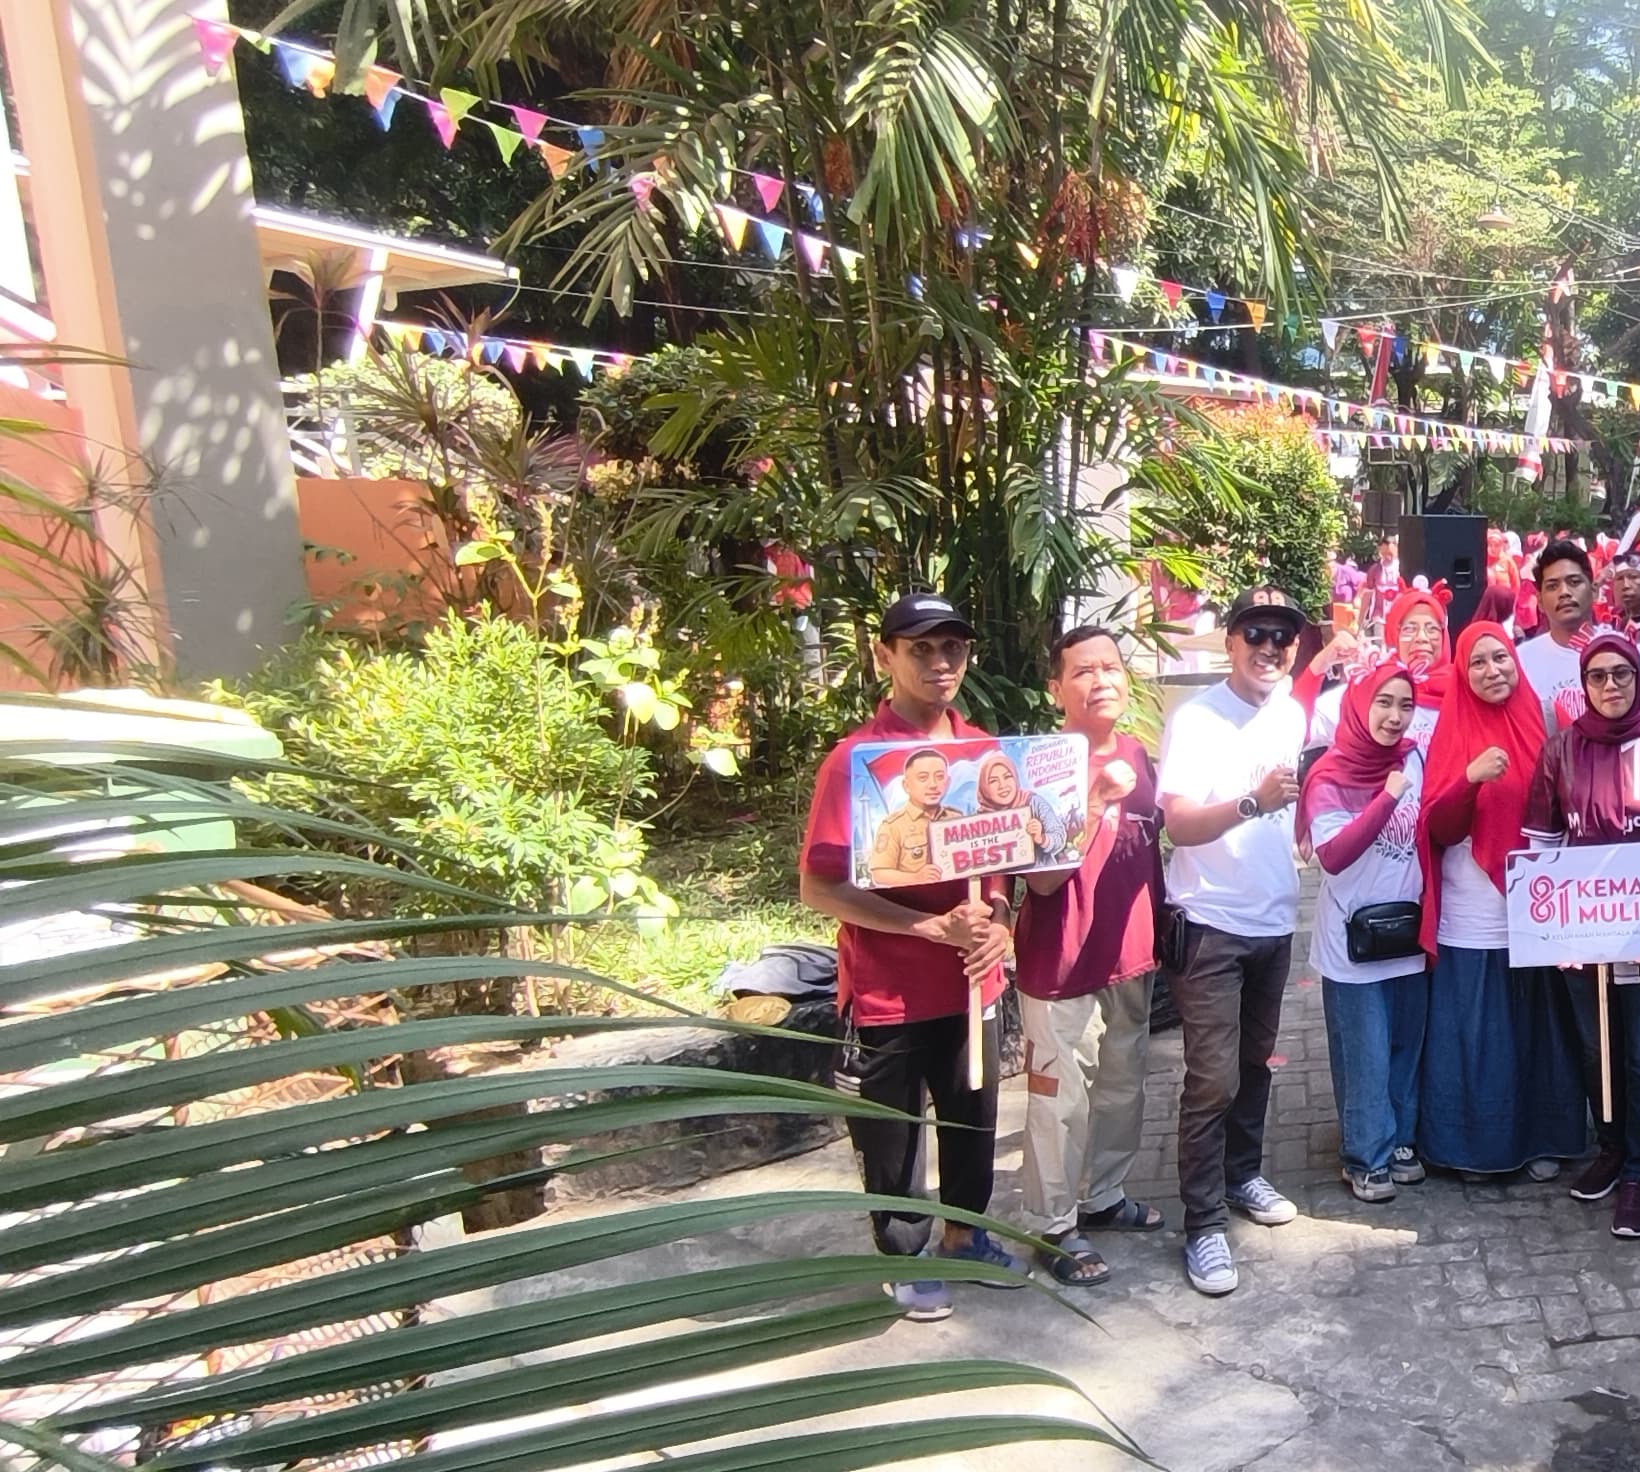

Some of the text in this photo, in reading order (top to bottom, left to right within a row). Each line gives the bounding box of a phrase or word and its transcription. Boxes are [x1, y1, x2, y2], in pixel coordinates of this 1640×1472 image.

[1028, 758, 1078, 779] INDONESIA
[943, 813, 1023, 845] MANDALA
[970, 836, 1000, 848] IS THE
[952, 841, 1018, 874] BEST
[1529, 875, 1575, 928] 81
